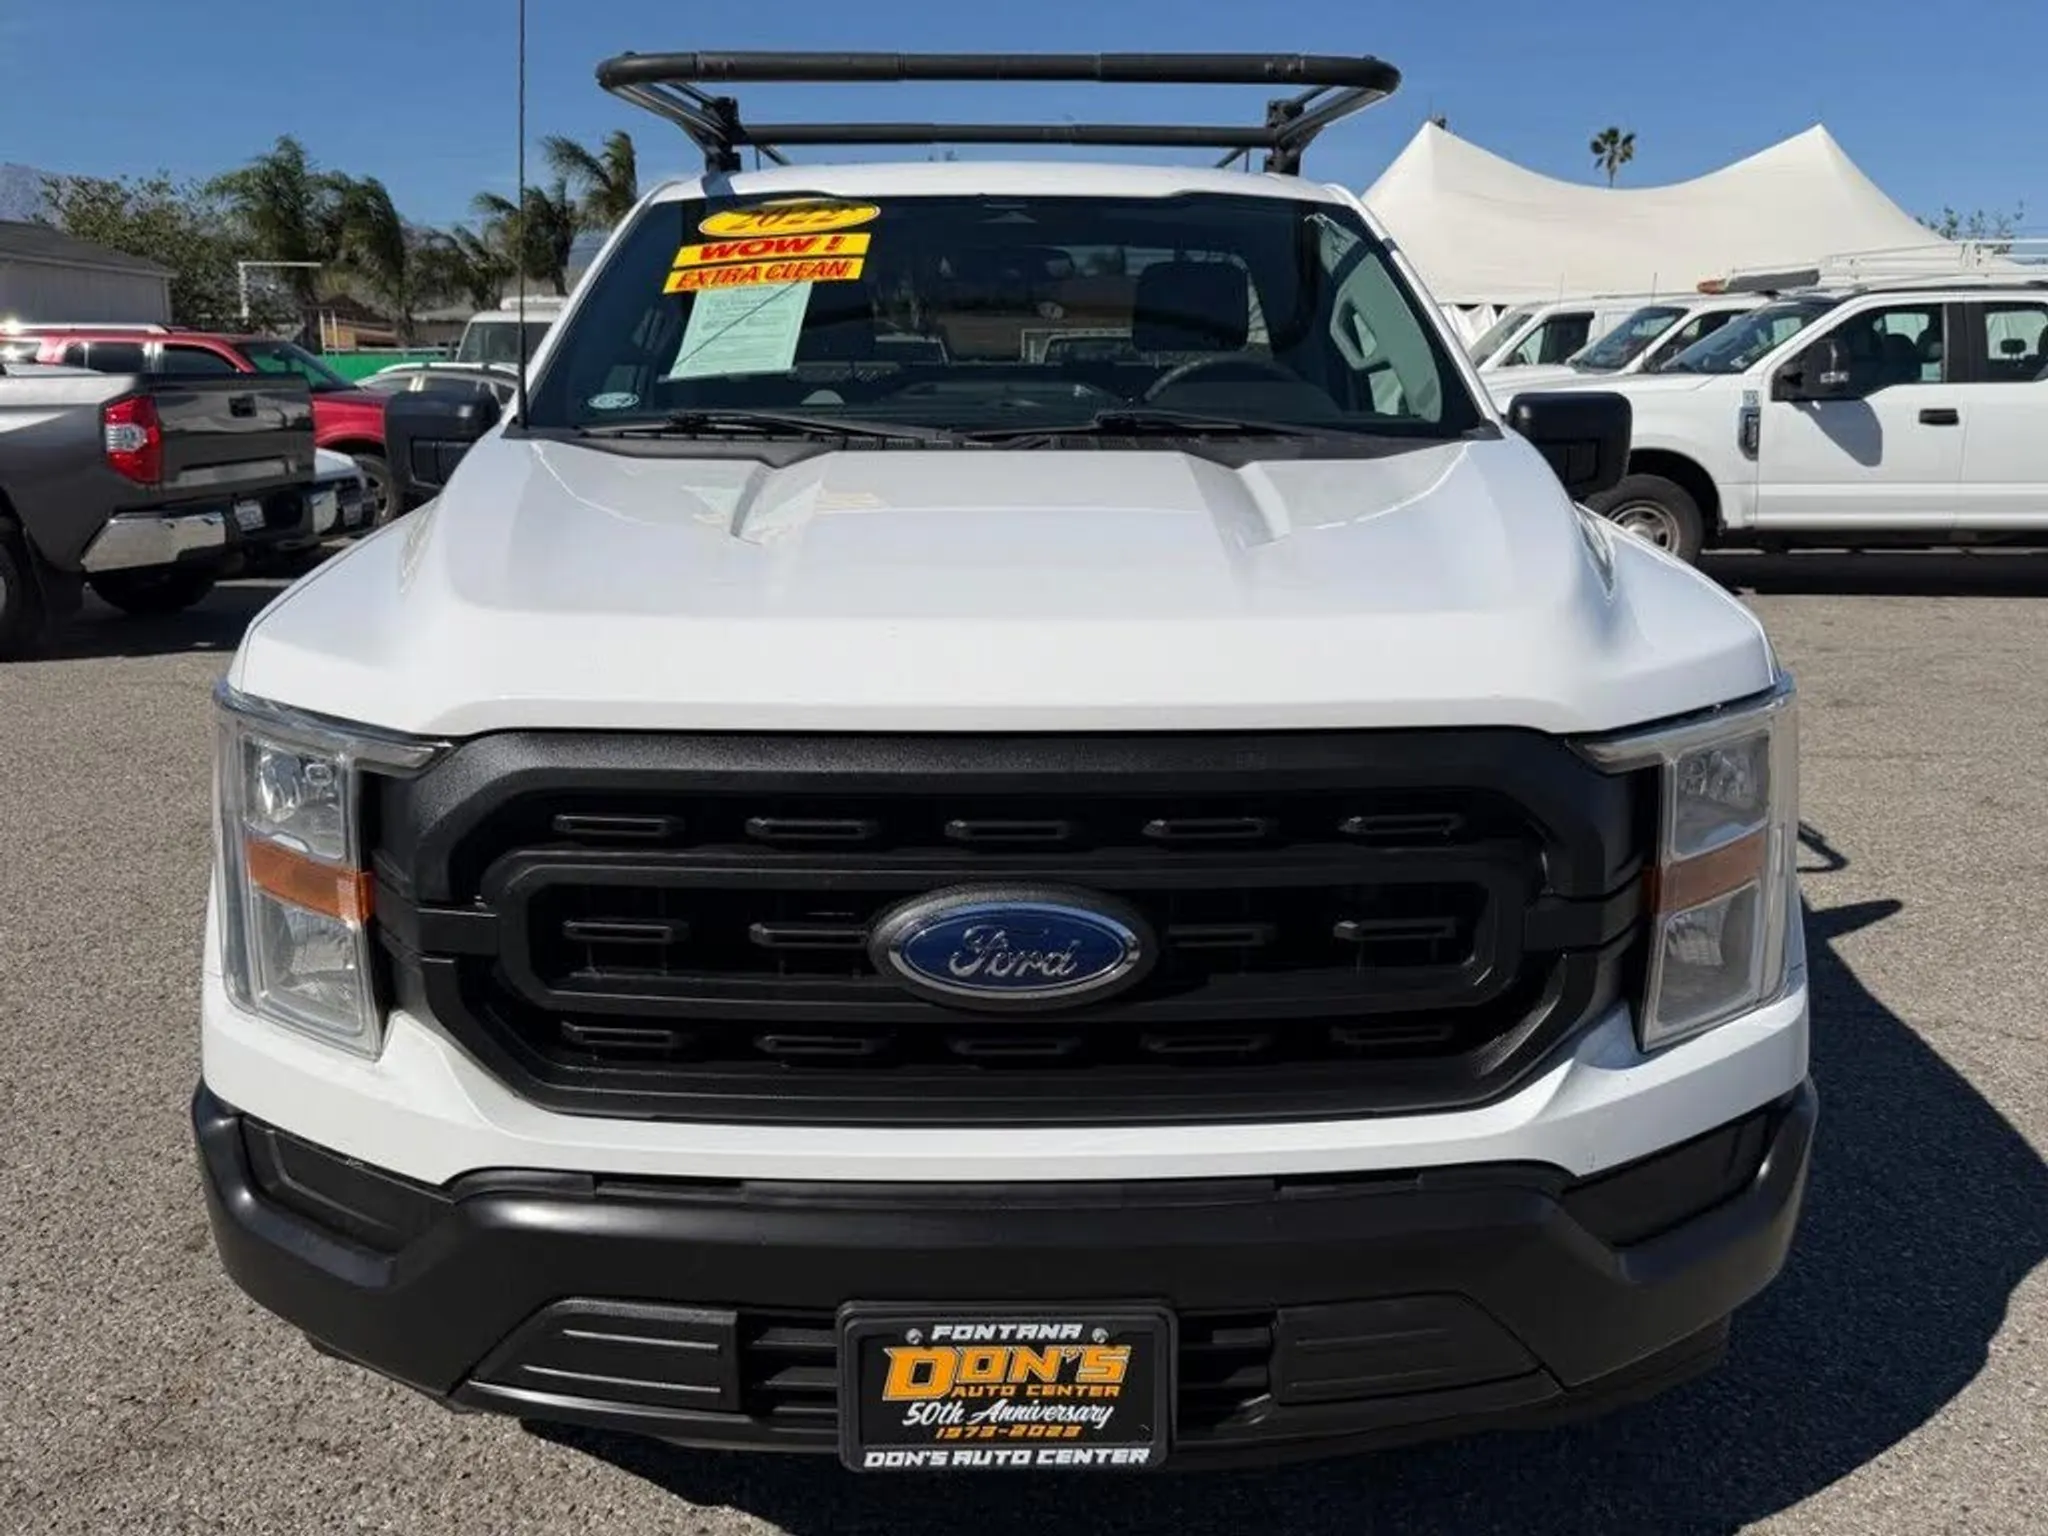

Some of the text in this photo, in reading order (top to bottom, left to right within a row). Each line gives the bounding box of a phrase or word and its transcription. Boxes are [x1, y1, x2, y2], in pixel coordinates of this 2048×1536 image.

[701, 237, 816, 260] WOW
[675, 260, 849, 289] EXTRA CLEAN
[949, 924, 1080, 978] Ford
[931, 1323, 1084, 1341] FONTANA
[950, 1384, 1121, 1399] AUTO CENTER
[902, 1399, 1114, 1430] 50th Anniversary
[863, 1447, 1151, 1468] DON'S AUTO CENTER
